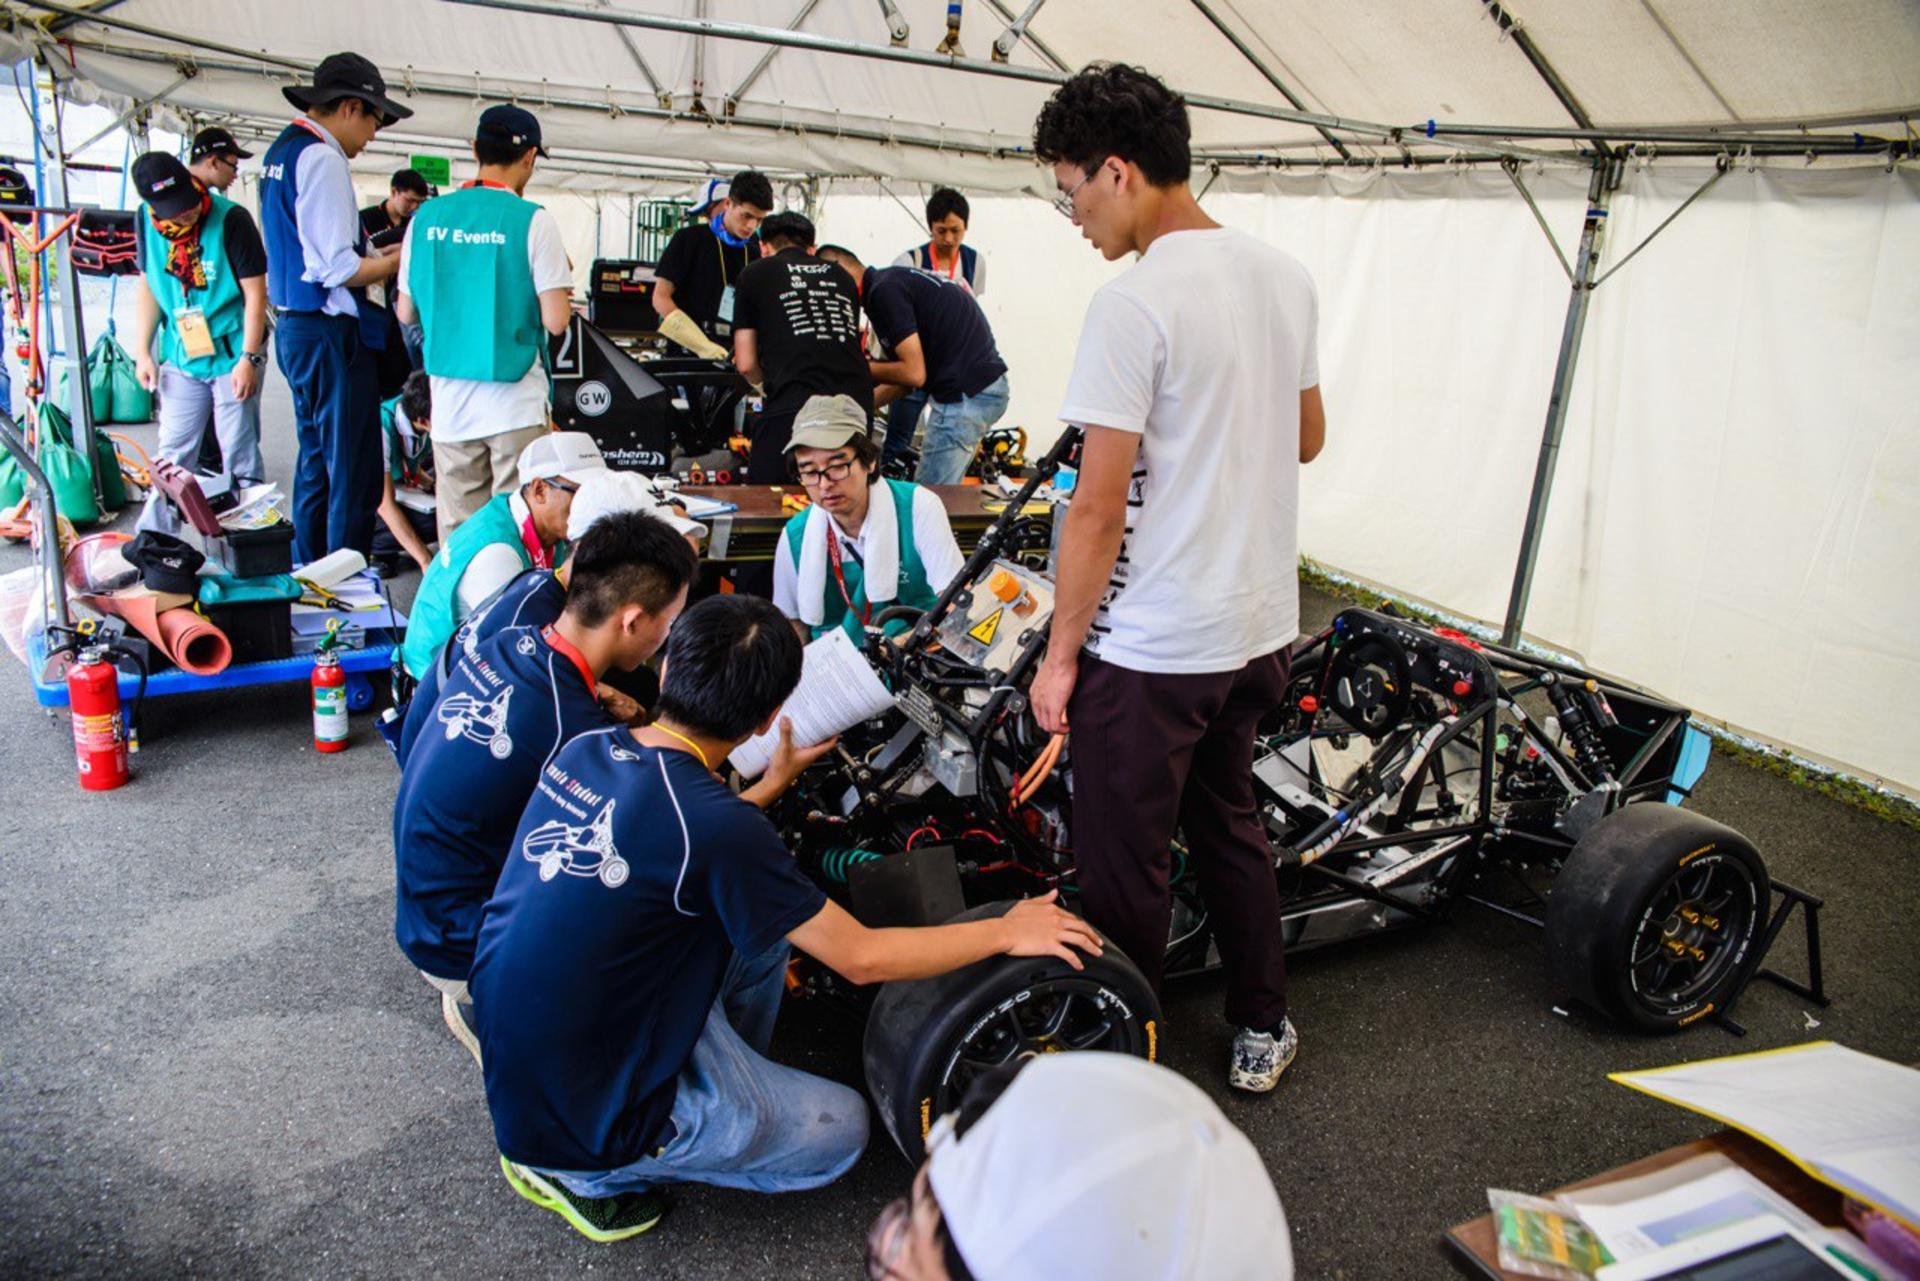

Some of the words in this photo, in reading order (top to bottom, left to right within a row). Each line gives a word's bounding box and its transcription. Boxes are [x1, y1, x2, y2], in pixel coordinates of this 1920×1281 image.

[427, 226, 449, 241] EV
[452, 228, 506, 245] Events
[565, 778, 603, 808] Student
